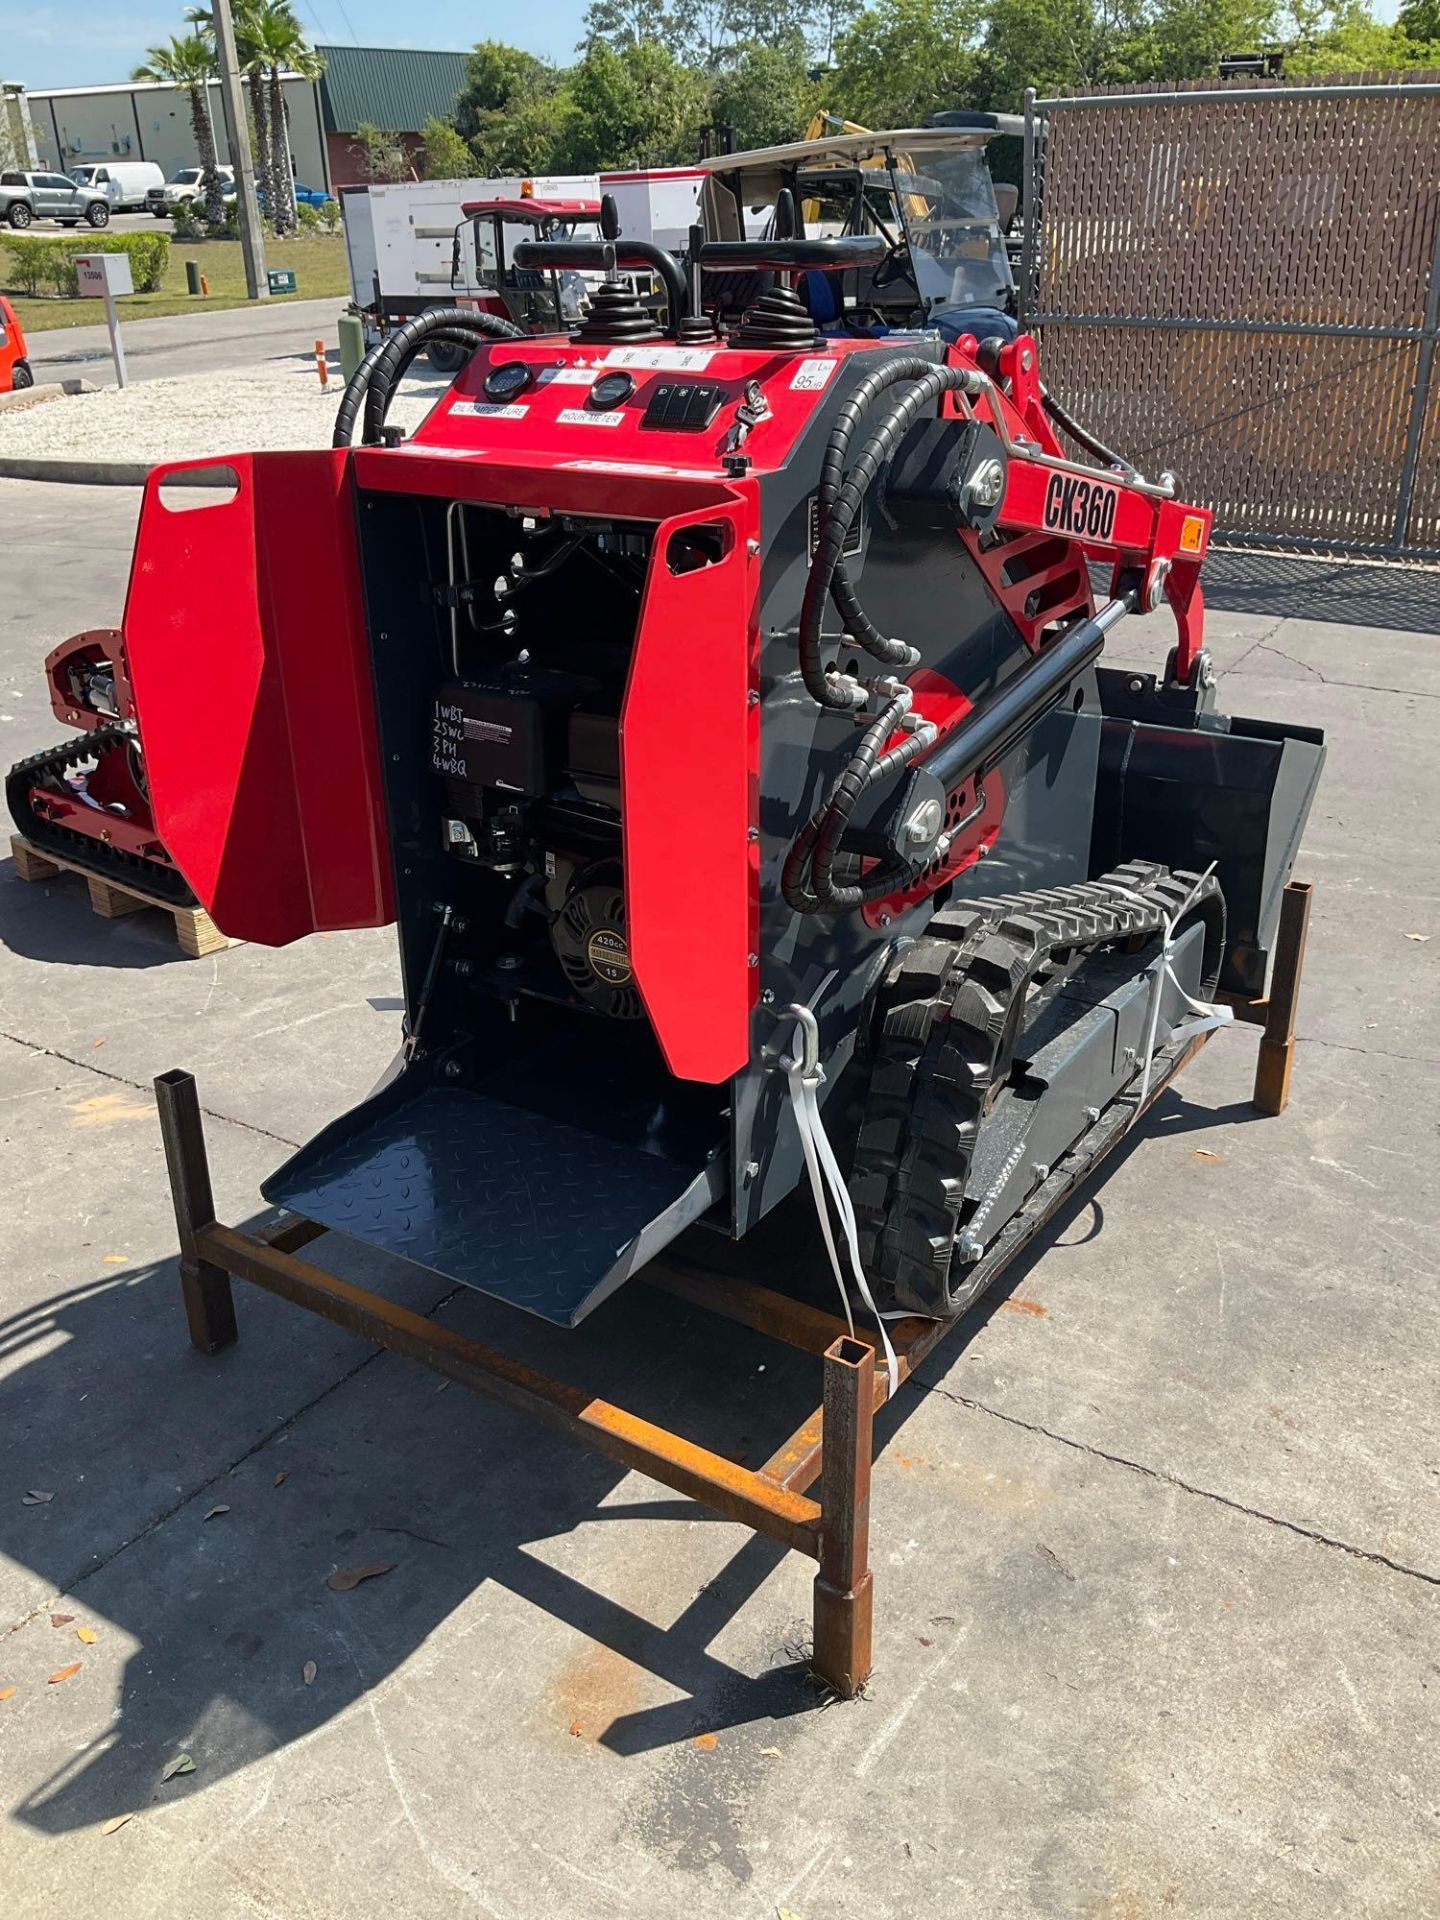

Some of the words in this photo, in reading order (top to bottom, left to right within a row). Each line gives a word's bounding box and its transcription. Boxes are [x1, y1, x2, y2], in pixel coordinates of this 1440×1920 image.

[453, 403, 469, 413] OIL
[468, 404, 525, 417] TEMPERATURE
[561, 412, 586, 421] HOUR
[588, 414, 620, 424] METER
[1044, 473, 1116, 539] CK360
[597, 936, 624, 949] 420cc
